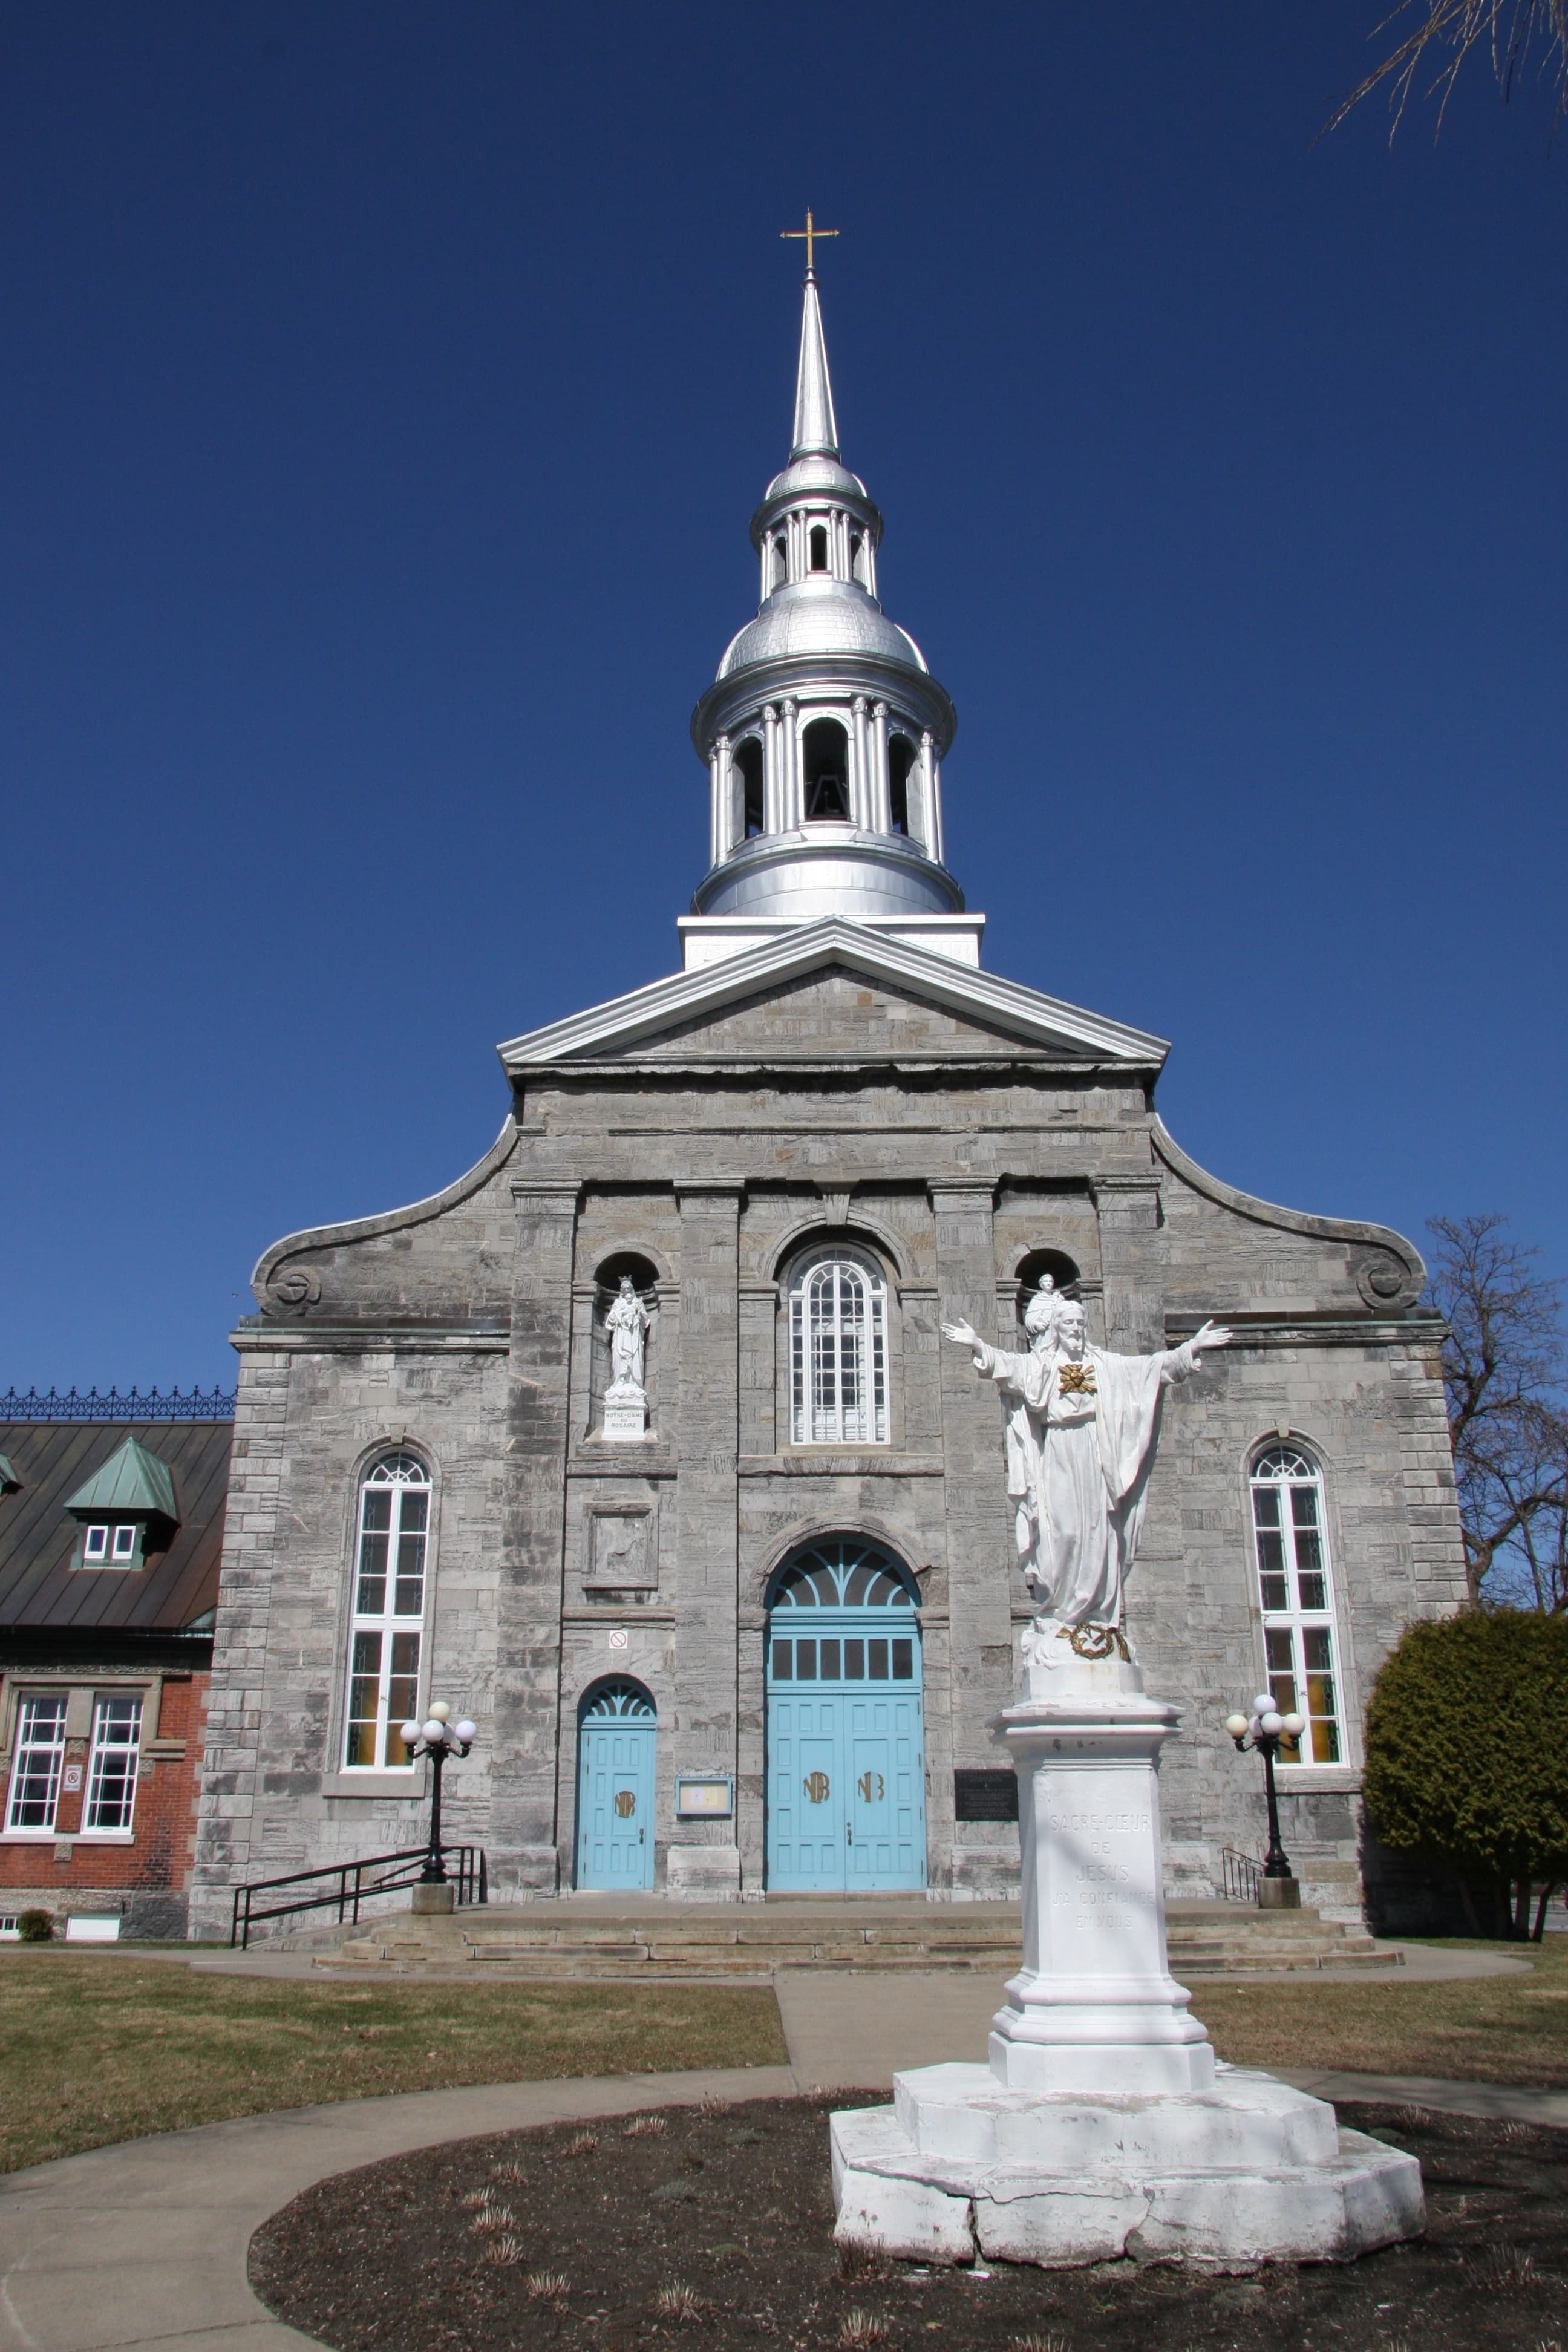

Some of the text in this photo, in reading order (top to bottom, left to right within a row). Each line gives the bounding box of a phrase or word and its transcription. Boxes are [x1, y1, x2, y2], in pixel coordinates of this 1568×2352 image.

[1091, 1841, 1111, 1855] DE
[1076, 1864, 1129, 1883] JESUS
[1080, 1892, 1156, 1906] CONFIANCE
[1077, 1915, 1133, 1930] EN VOUS
